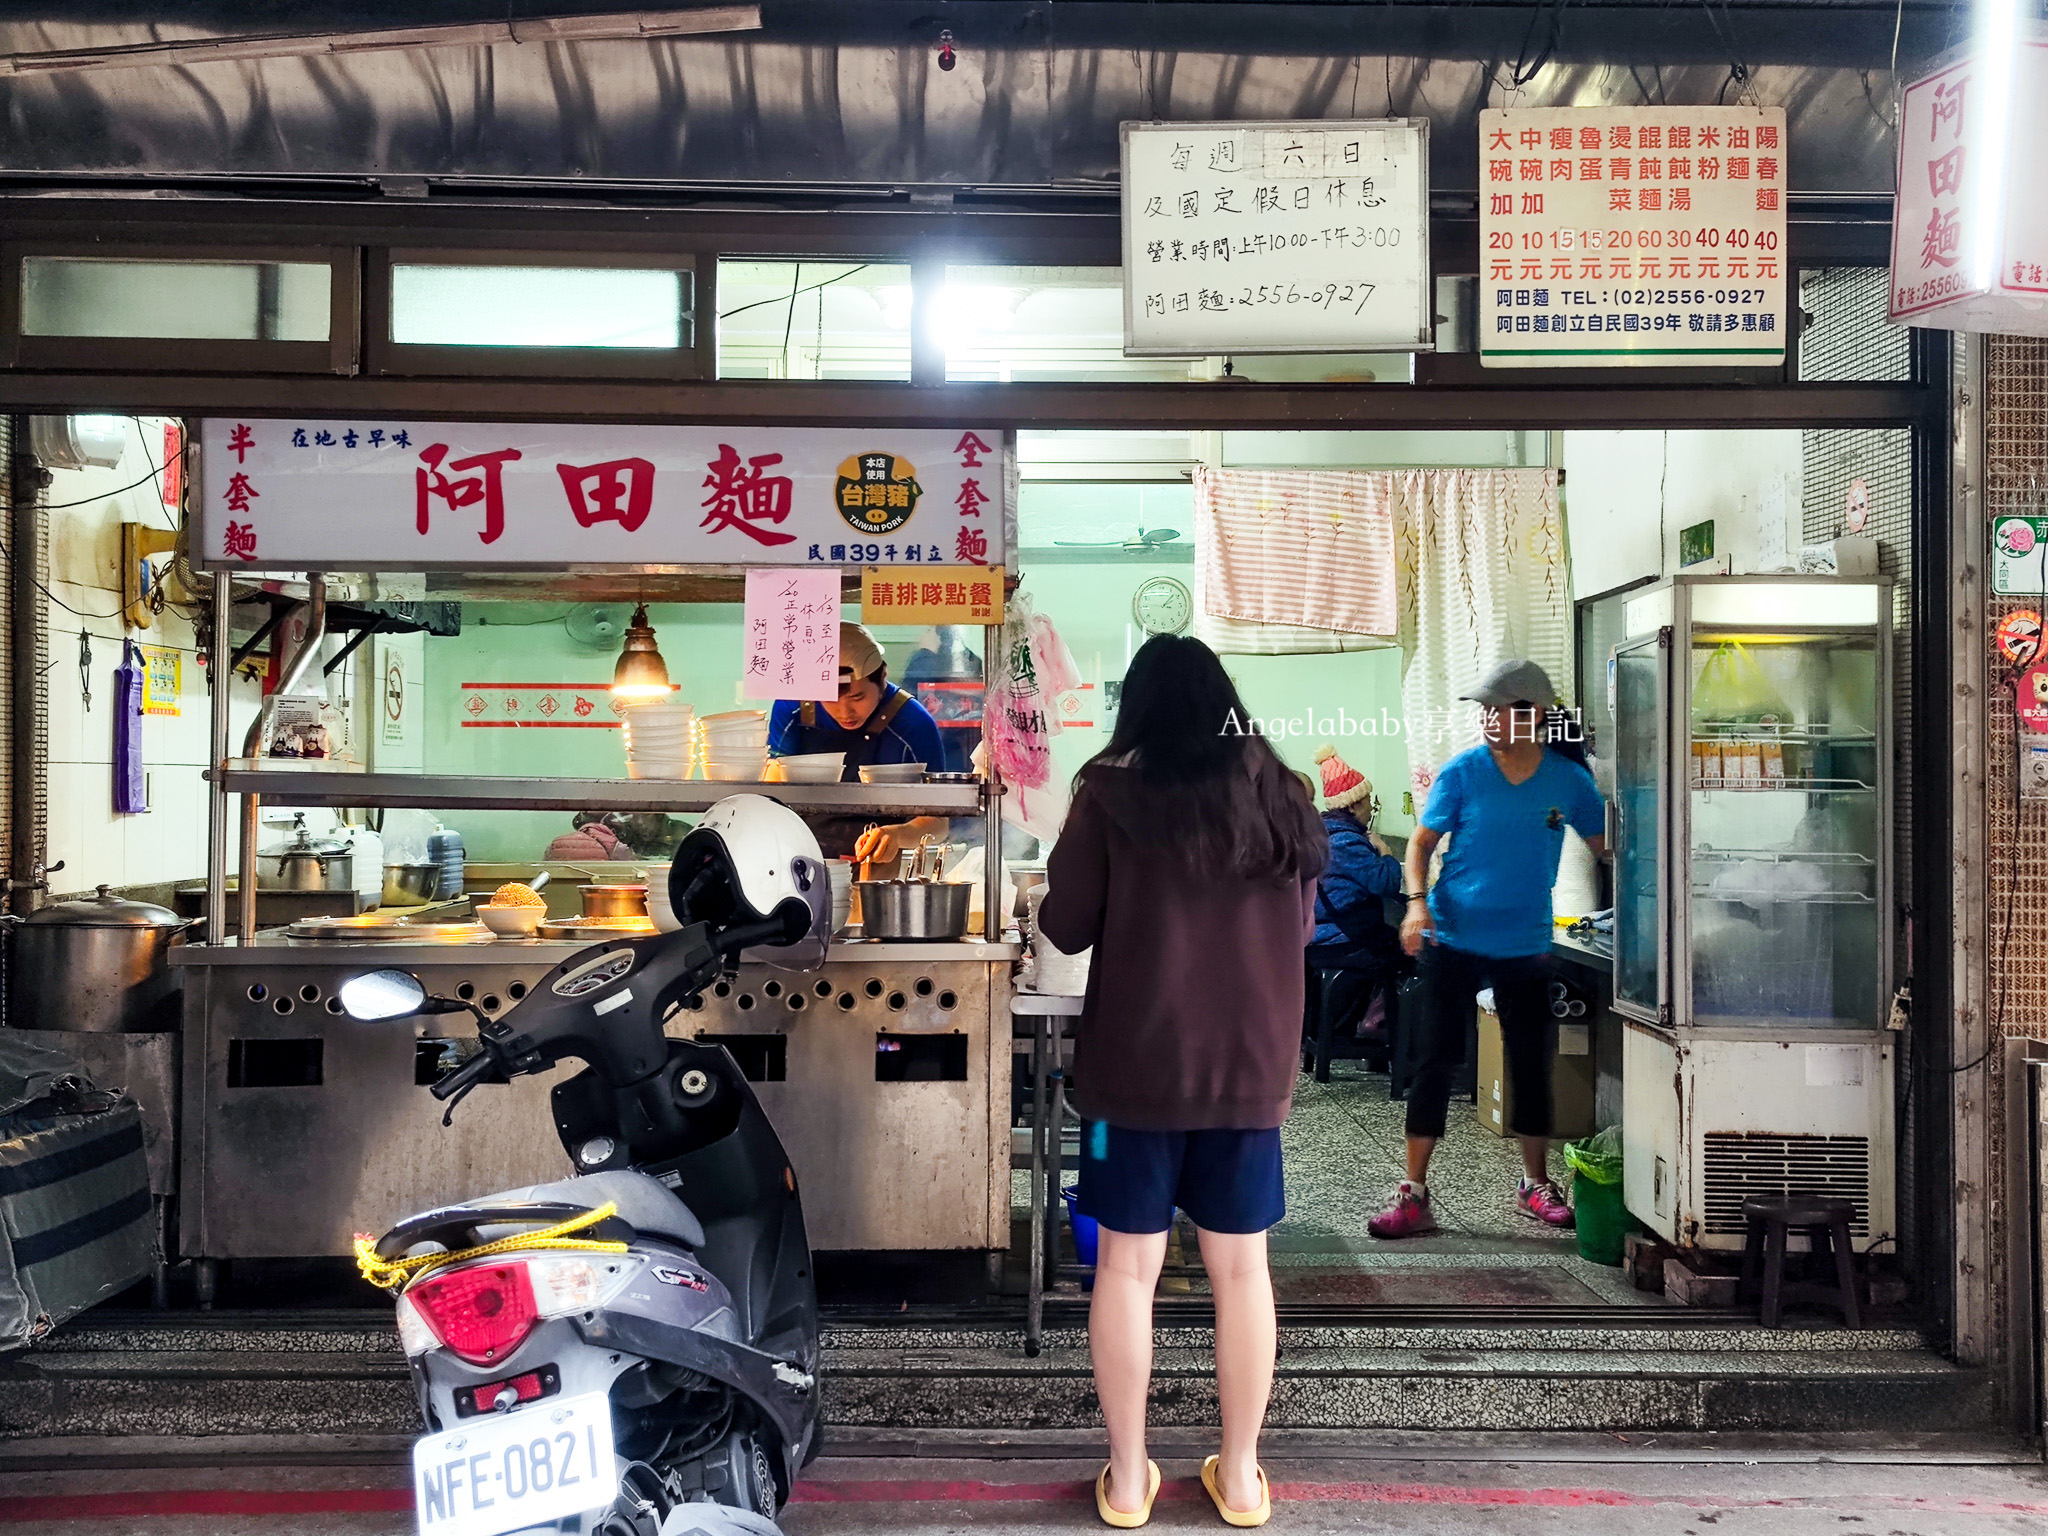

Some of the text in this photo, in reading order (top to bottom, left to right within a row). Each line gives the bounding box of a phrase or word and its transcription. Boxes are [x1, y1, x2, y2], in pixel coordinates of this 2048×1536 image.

[1550, 127, 1572, 181] 瘦肉
[1580, 127, 1602, 180] 魯蛋
[1698, 126, 1720, 180] 米粉
[1727, 127, 1749, 179] 油麵
[1490, 129, 1512, 215] 大碗加
[1520, 128, 1543, 214] 中碗加
[1609, 126, 1632, 211] 燙青菜
[1639, 126, 1662, 211] 餛飩麵
[1668, 127, 1691, 210] 餛飩湯
[1756, 126, 1778, 210] 陽春麵
[1919, 75, 1972, 270] 阿田麵
[1144, 177, 1386, 218] 及國定假日休息
[1490, 232, 1513, 249] 20
[1522, 232, 1543, 249] 10
[1550, 229, 1574, 249] 15
[1579, 229, 1602, 250] 15
[1608, 231, 1632, 248] 20
[1638, 231, 1662, 247] 60
[1668, 231, 1691, 247] 30
[1696, 228, 1719, 247] 40
[1726, 229, 1749, 248] 40
[1754, 231, 1777, 250] 40
[1497, 289, 1549, 307] 阿田麵
[1896, 270, 1976, 309] 電話:255609
[1497, 313, 1775, 333] 阿田麵創立自民國39年 敬請多惠顧
[291, 428, 412, 449] 在地古早味
[866, 458, 885, 468] 本店
[866, 470, 885, 480] 使用
[223, 424, 260, 561] 半套麵
[416, 443, 798, 546] 阿田麵
[841, 484, 910, 507] 台灣豬
[953, 431, 993, 566] 全套麵
[849, 515, 904, 532] TAIWAN PORK
[808, 544, 943, 561] 民國39年創立
[872, 582, 991, 606] 請排隊點餐
[423, 1424, 598, 1524] NFE-0821
